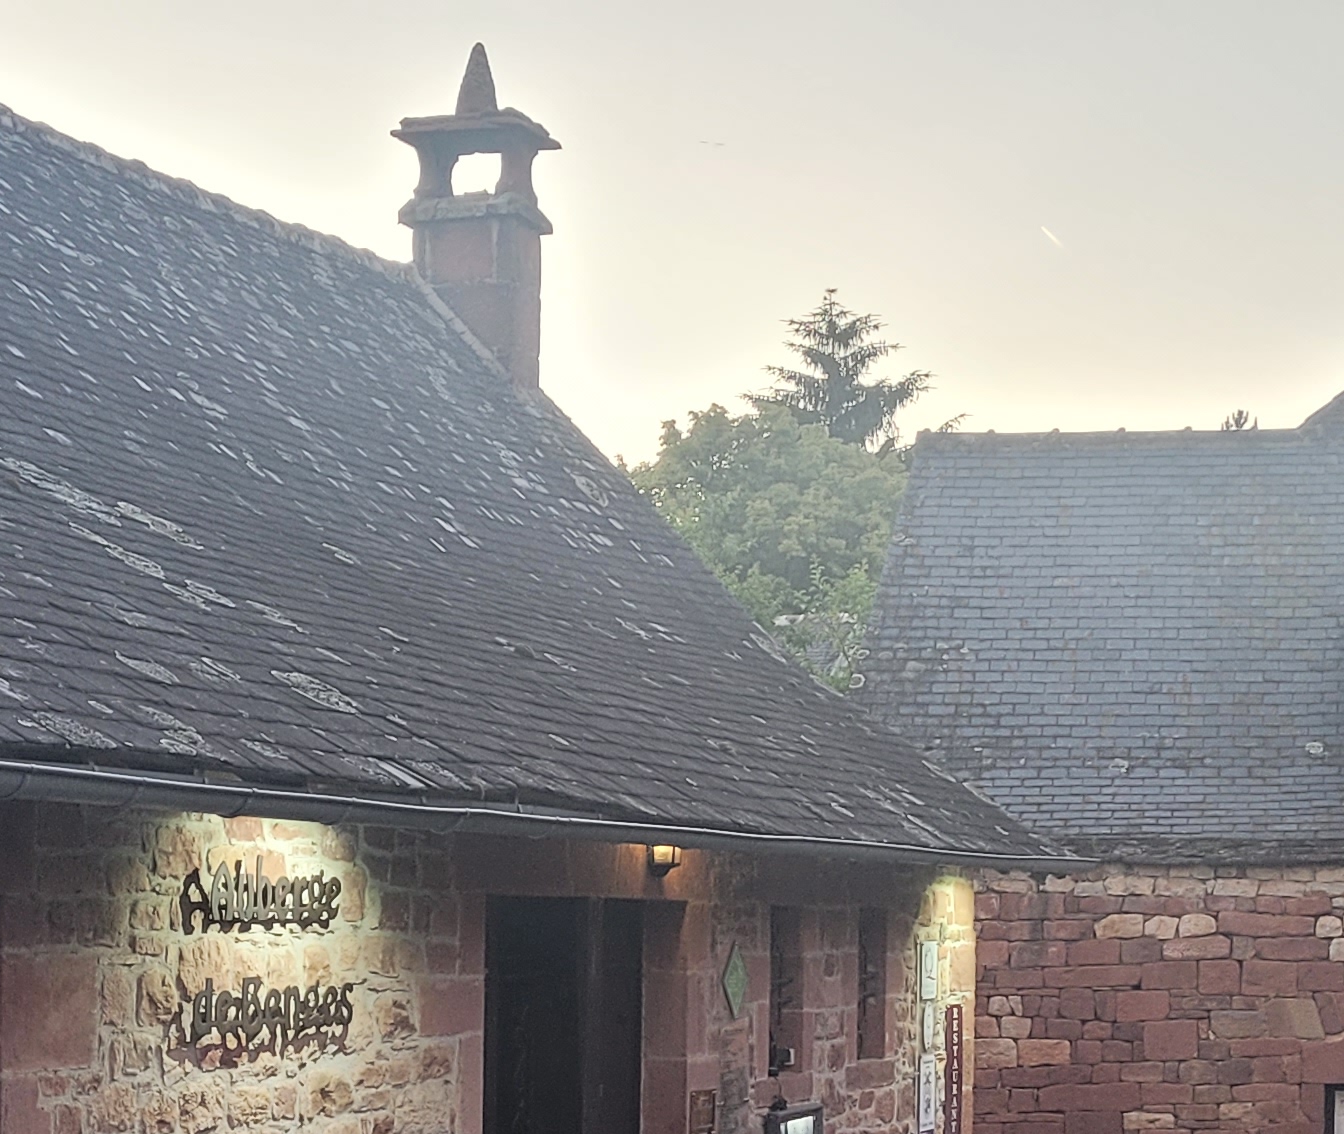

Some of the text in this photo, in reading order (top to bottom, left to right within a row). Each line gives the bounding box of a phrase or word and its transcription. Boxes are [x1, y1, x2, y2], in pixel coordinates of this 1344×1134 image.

[210, 855, 342, 922] Auberge
[193, 976, 367, 1037] de Benges
[950, 1007, 960, 1133] RESTAURANT
